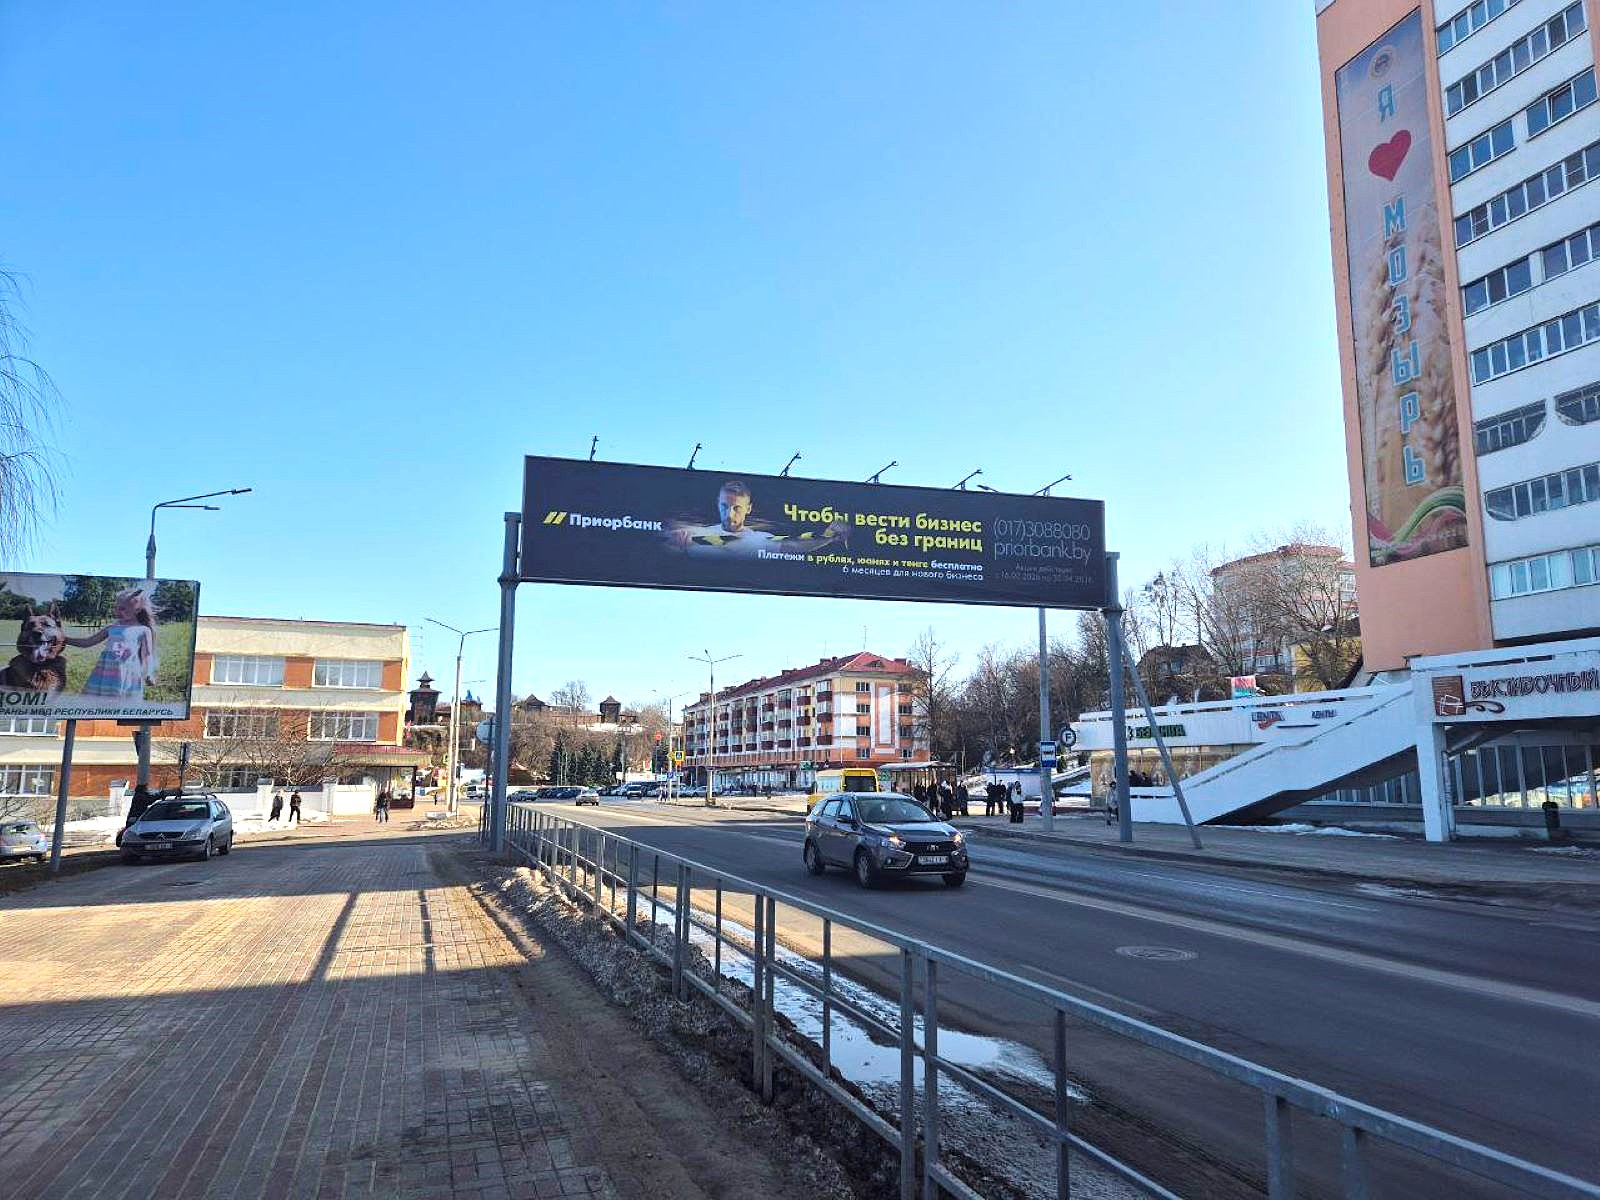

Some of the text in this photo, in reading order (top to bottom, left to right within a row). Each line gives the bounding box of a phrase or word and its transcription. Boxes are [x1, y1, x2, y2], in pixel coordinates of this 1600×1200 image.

[1377, 82, 1426, 487] Я МОЗЫРЬ
[569, 513, 663, 532] Приорбанк
[783, 503, 982, 533] Чтобы вести бизнес
[875, 529, 983, 552] без границ
[757, 549, 805, 561] Платежи
[807, 554, 814, 562] в
[857, 557, 890, 567] юанях
[902, 560, 929, 568] тенге
[930, 559, 983, 572] бесплатно
[851, 567, 891, 576] месяцев
[893, 569, 909, 577] для
[911, 569, 944, 579] нового
[945, 570, 984, 581] бизнеса
[54, 707, 121, 716] РЕСПУБЛИКИ
[122, 708, 173, 716] БЕЛАРУСЬ
